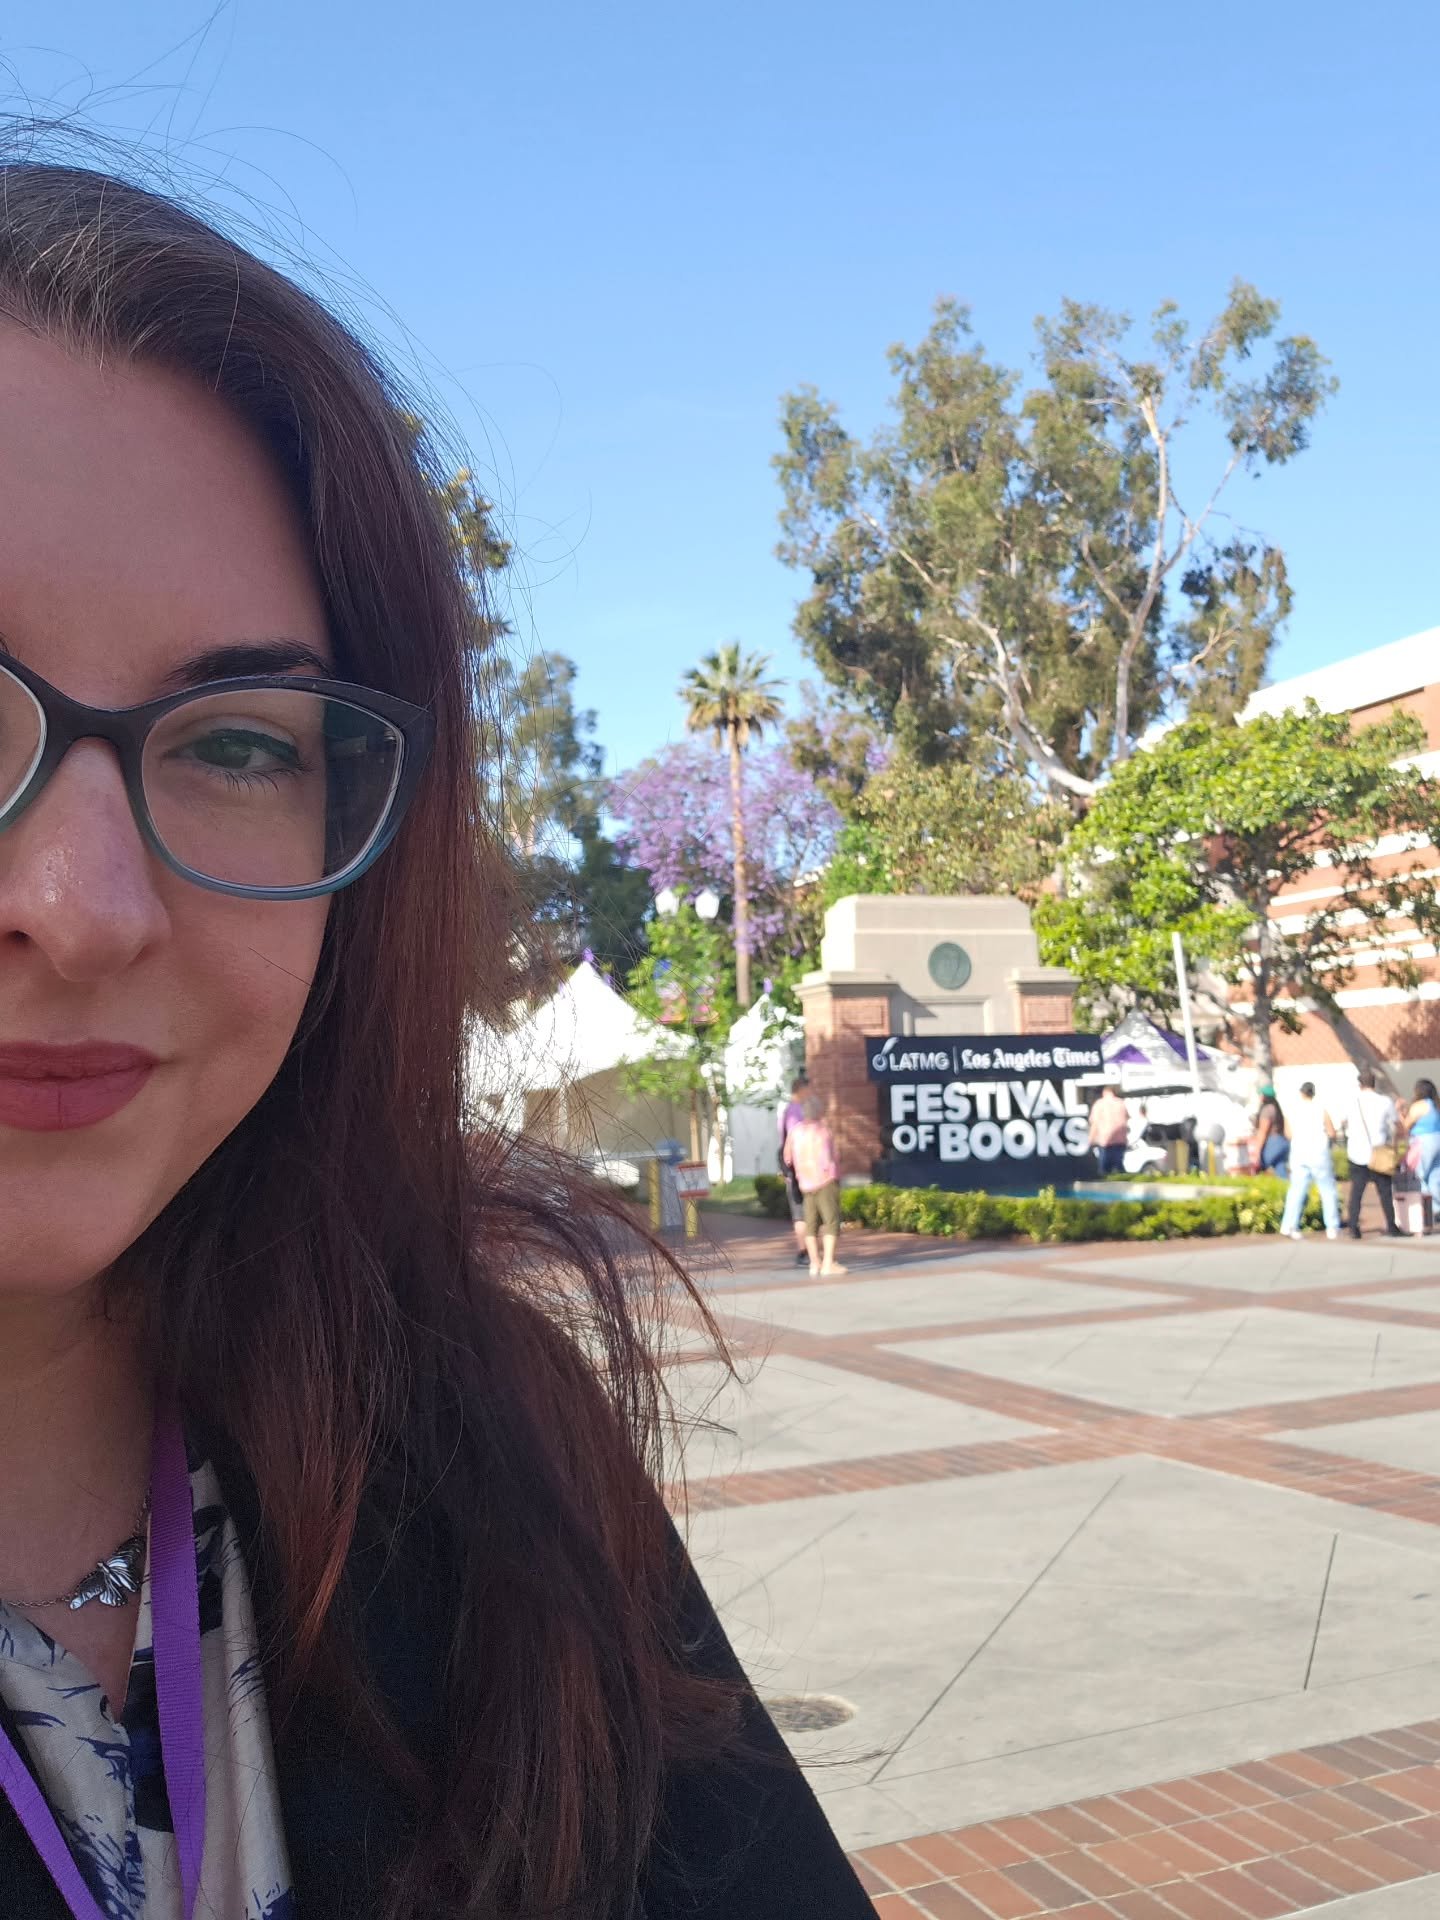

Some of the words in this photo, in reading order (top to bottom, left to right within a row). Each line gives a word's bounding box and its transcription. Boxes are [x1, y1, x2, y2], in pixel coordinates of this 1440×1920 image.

[890, 1052, 950, 1071] LATMG
[961, 1048, 990, 1069] Los
[993, 1048, 1050, 1072] Angeles
[1053, 1047, 1099, 1067] Times
[890, 1079, 1088, 1123] FESTIVAL
[892, 1124, 935, 1153] OF
[939, 1117, 1090, 1162] BOOKS
